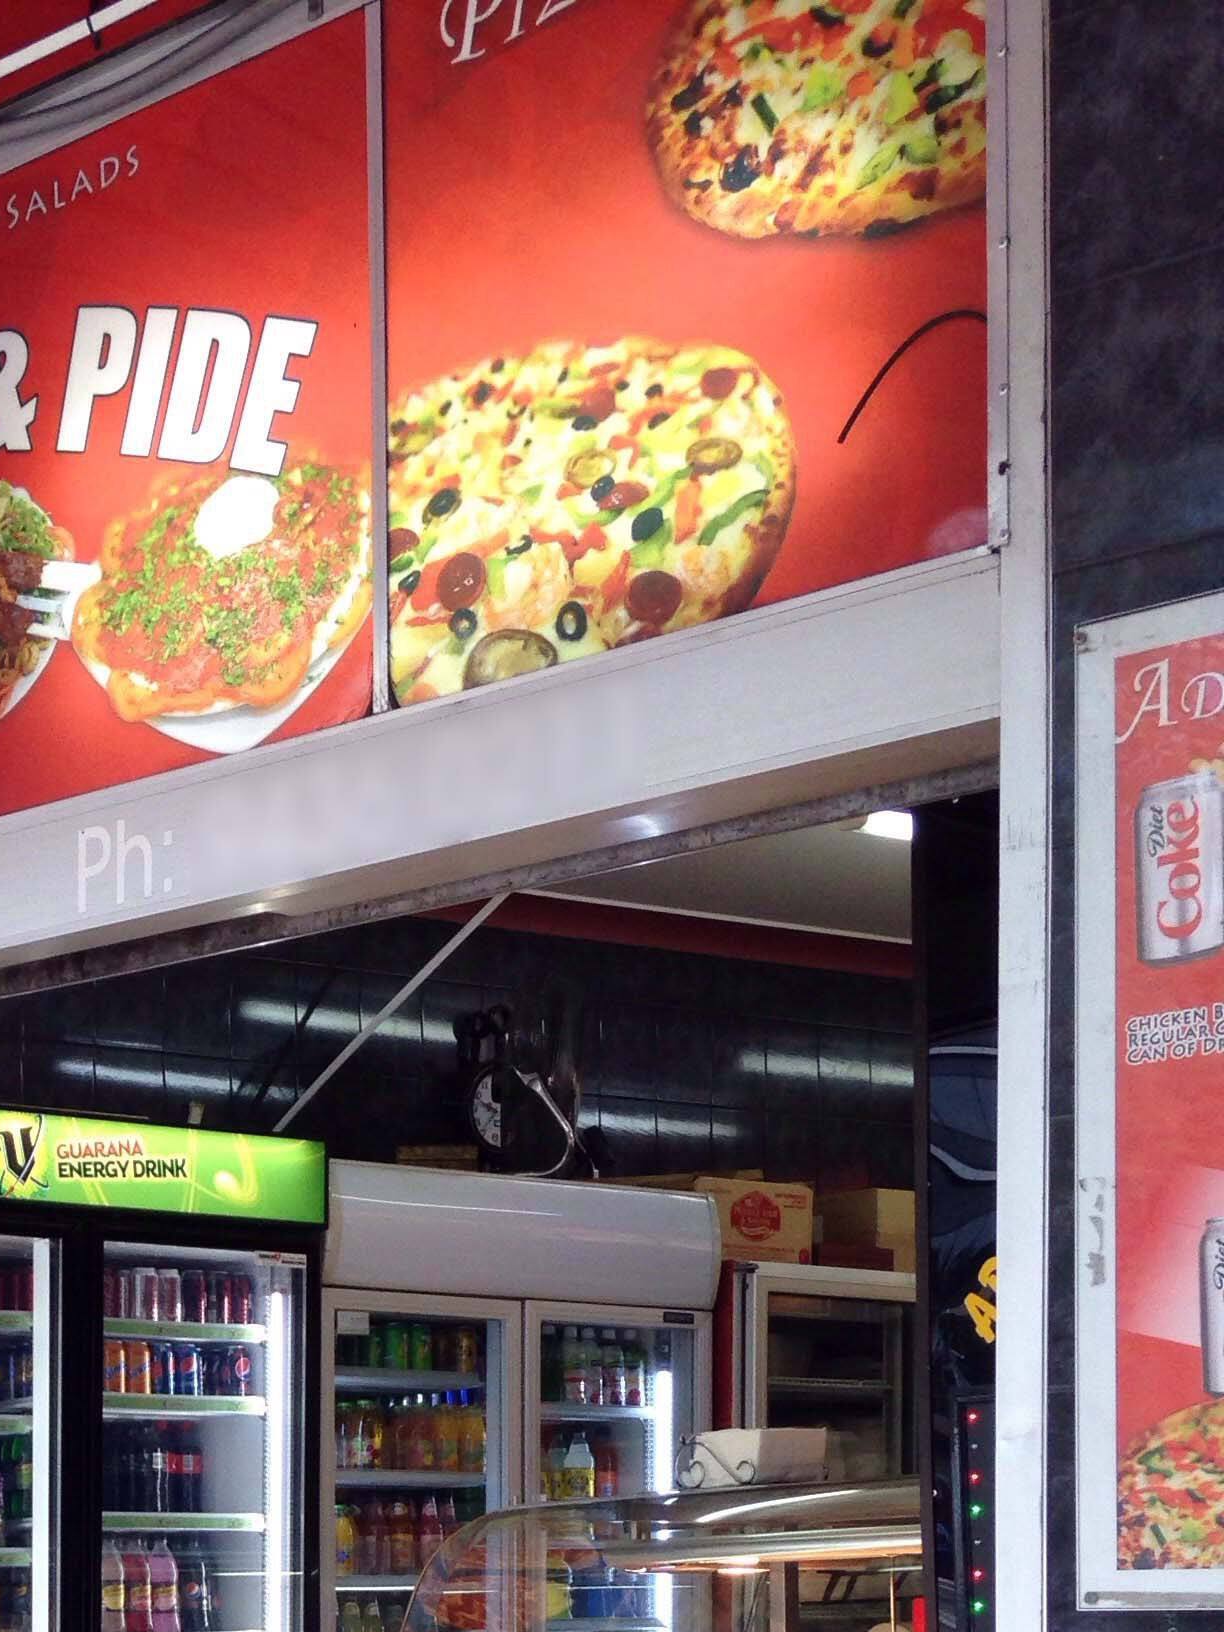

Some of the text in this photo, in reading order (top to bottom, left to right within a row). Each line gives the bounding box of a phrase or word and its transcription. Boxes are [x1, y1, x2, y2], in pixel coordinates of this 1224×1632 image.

[56, 305, 319, 477] PIDE
[1147, 804, 1165, 857] Diet
[78, 819, 173, 913] Ph:
[1157, 795, 1203, 940] Coke
[1127, 1007, 1207, 1033] CHICKEN
[1128, 1024, 1209, 1048] REGULAR
[1127, 1046, 1166, 1064] CAN
[1172, 1042, 1196, 1058] OF
[56, 1138, 144, 1160] GUARANA
[58, 1158, 188, 1179] ENERGY DRINK
